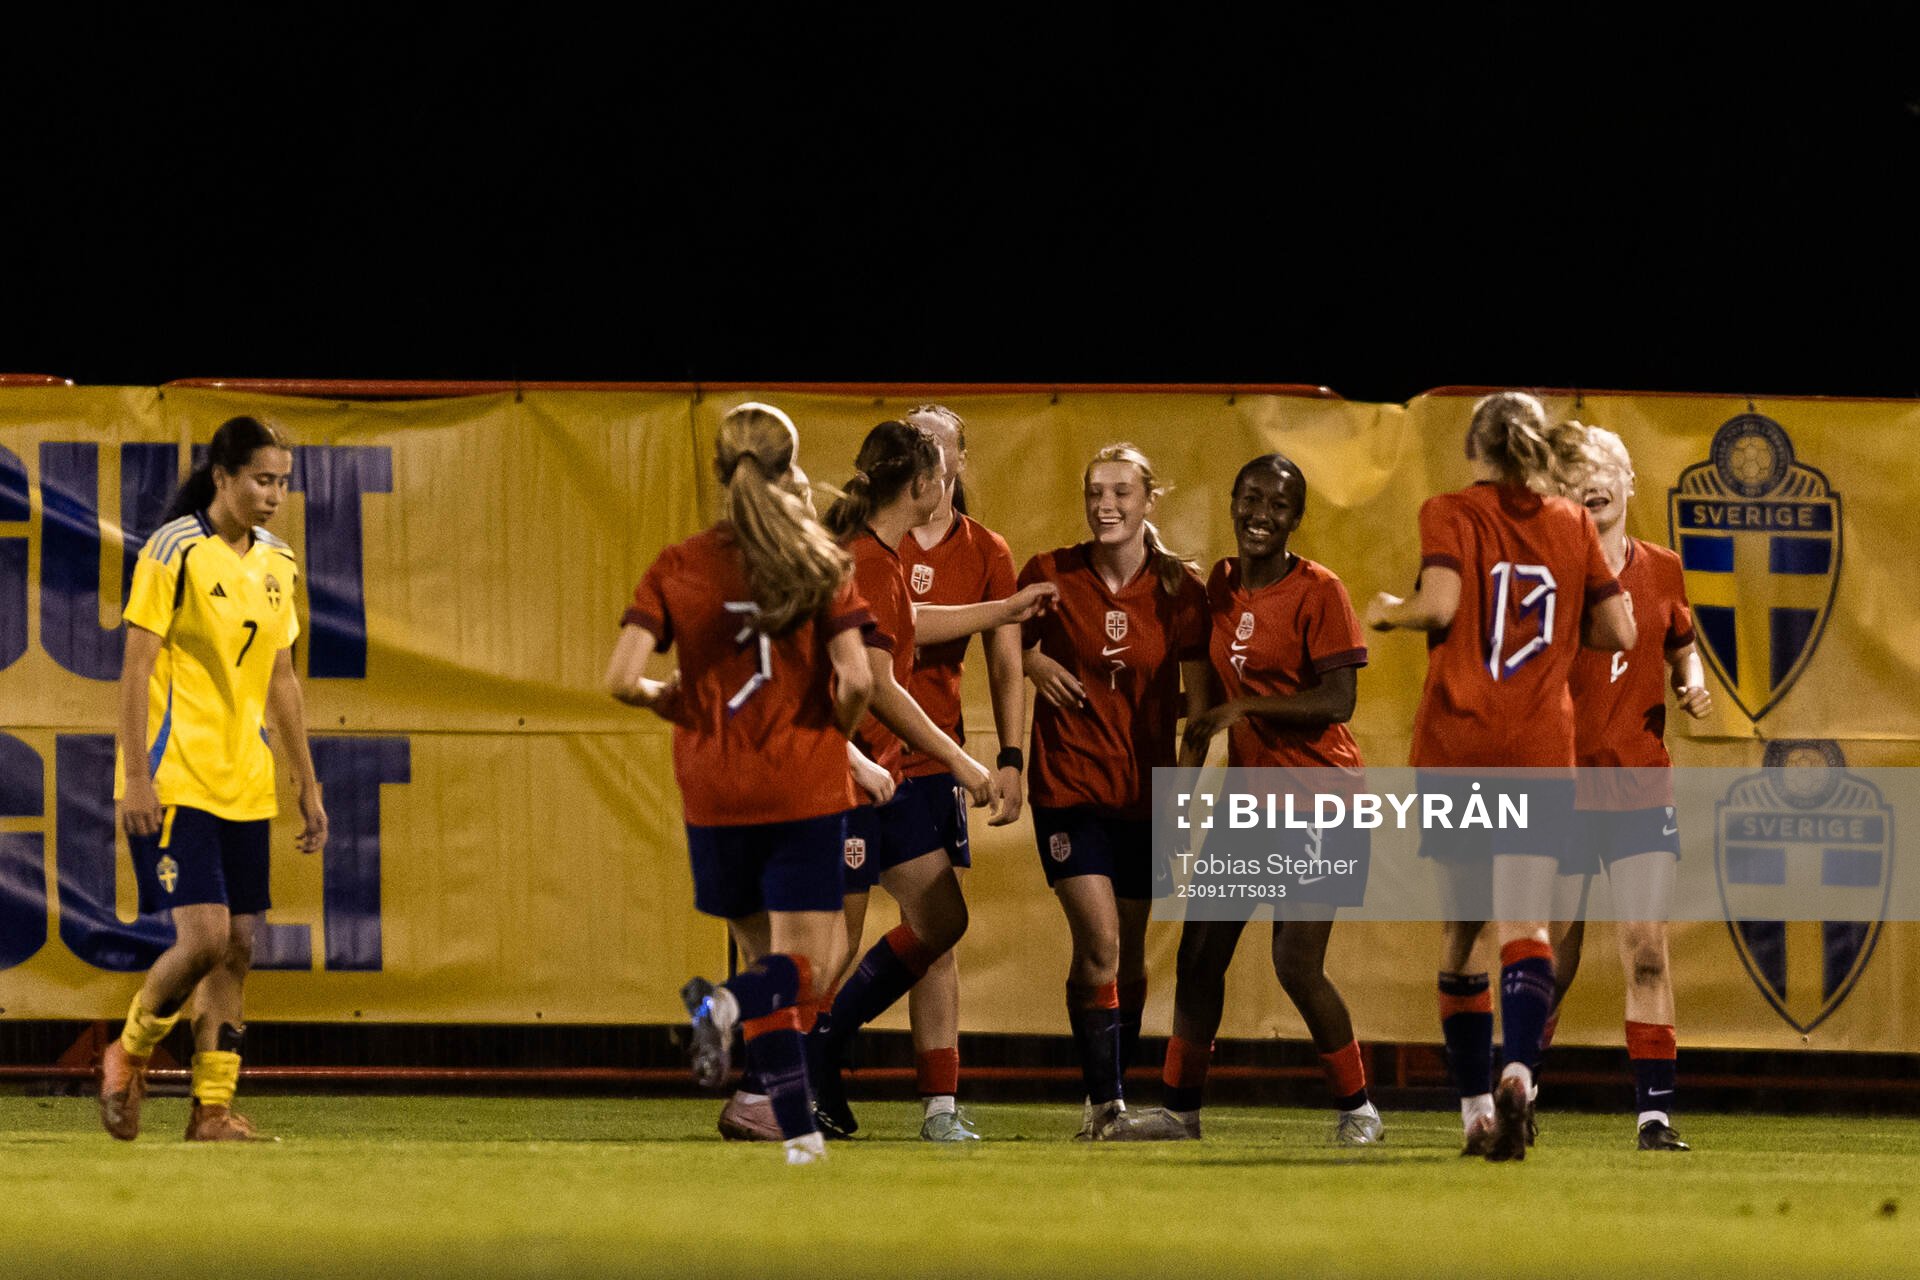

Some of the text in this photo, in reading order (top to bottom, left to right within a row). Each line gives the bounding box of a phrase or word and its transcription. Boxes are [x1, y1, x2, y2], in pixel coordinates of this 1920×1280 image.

[1693, 504, 1813, 527] SVERIGE
[1489, 561, 1557, 681] 13
[236, 620, 258, 667] 7
[1743, 816, 1864, 839] SVERIGE
